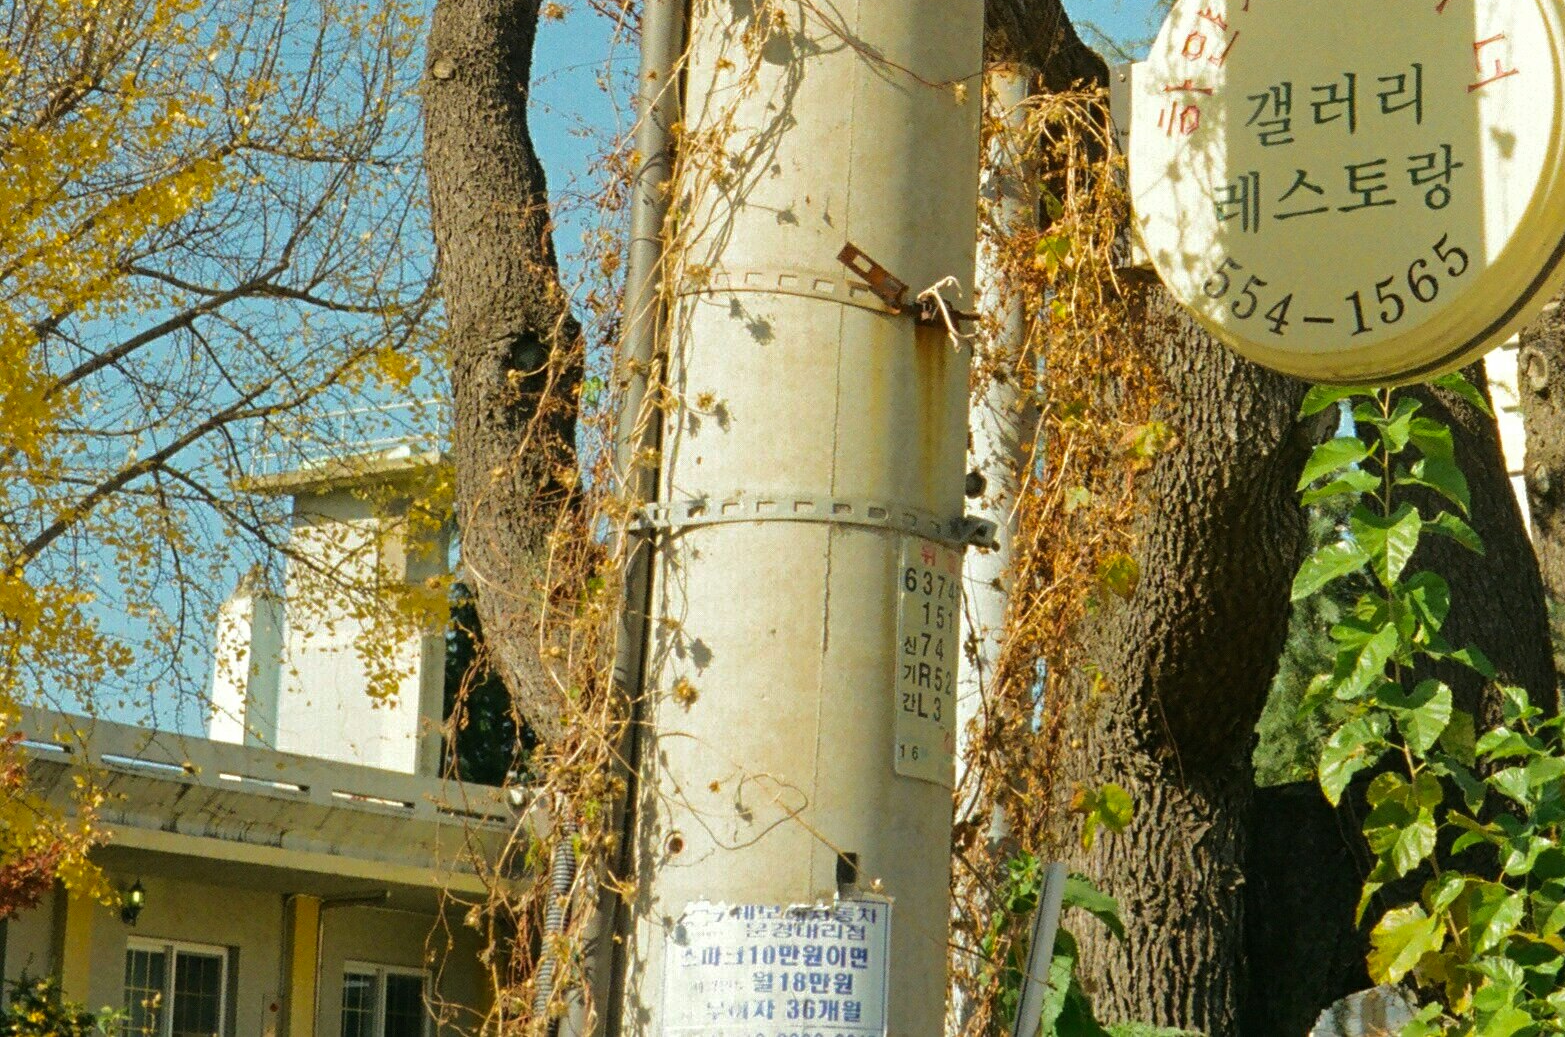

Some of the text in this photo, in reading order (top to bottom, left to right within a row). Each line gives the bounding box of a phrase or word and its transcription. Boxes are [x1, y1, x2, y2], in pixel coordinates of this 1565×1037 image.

[1466, 31, 1520, 93] 너
[1244, 62, 1426, 148] 갤러리
[1213, 143, 1465, 235] 레스토랑
[1202, 231, 1471, 338] 554-1565
[904, 566, 958, 605] 6374
[921, 600, 954, 634] 151
